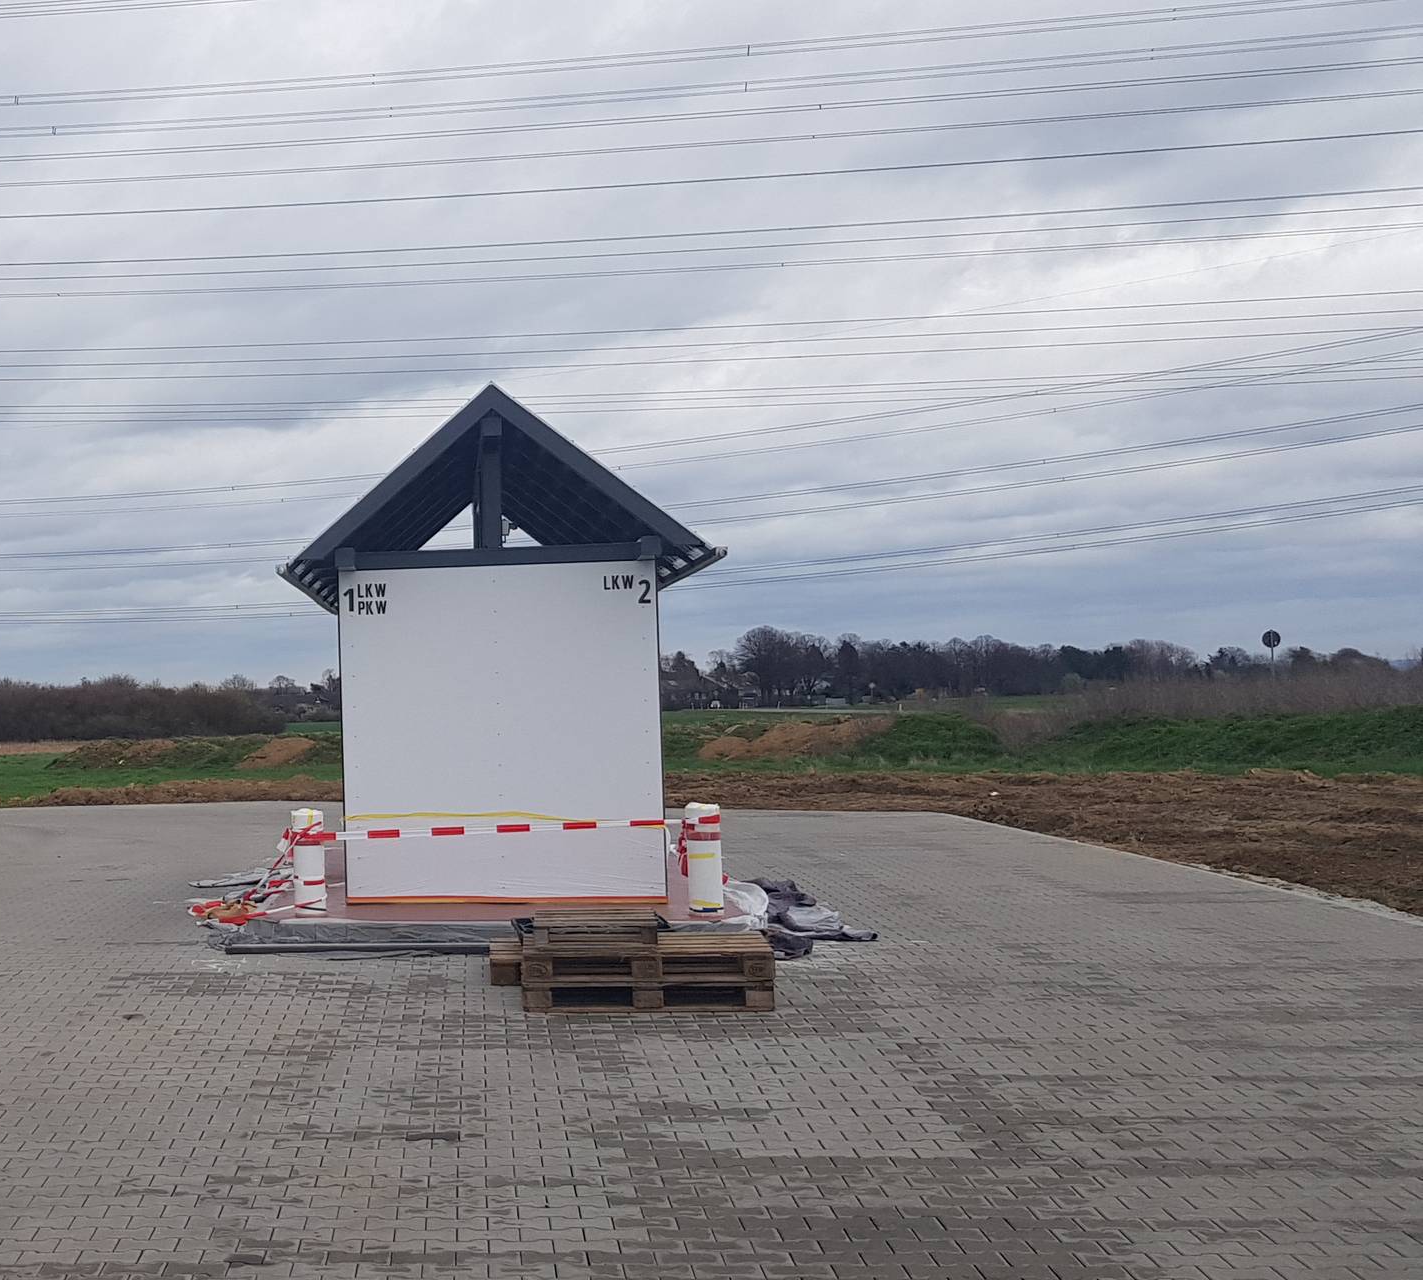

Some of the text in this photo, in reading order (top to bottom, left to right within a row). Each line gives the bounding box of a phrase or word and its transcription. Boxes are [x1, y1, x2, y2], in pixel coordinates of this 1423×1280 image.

[343, 583, 386, 612] 1 LKW
[603, 574, 652, 604] LKW 2
[358, 600, 387, 615] PKW
